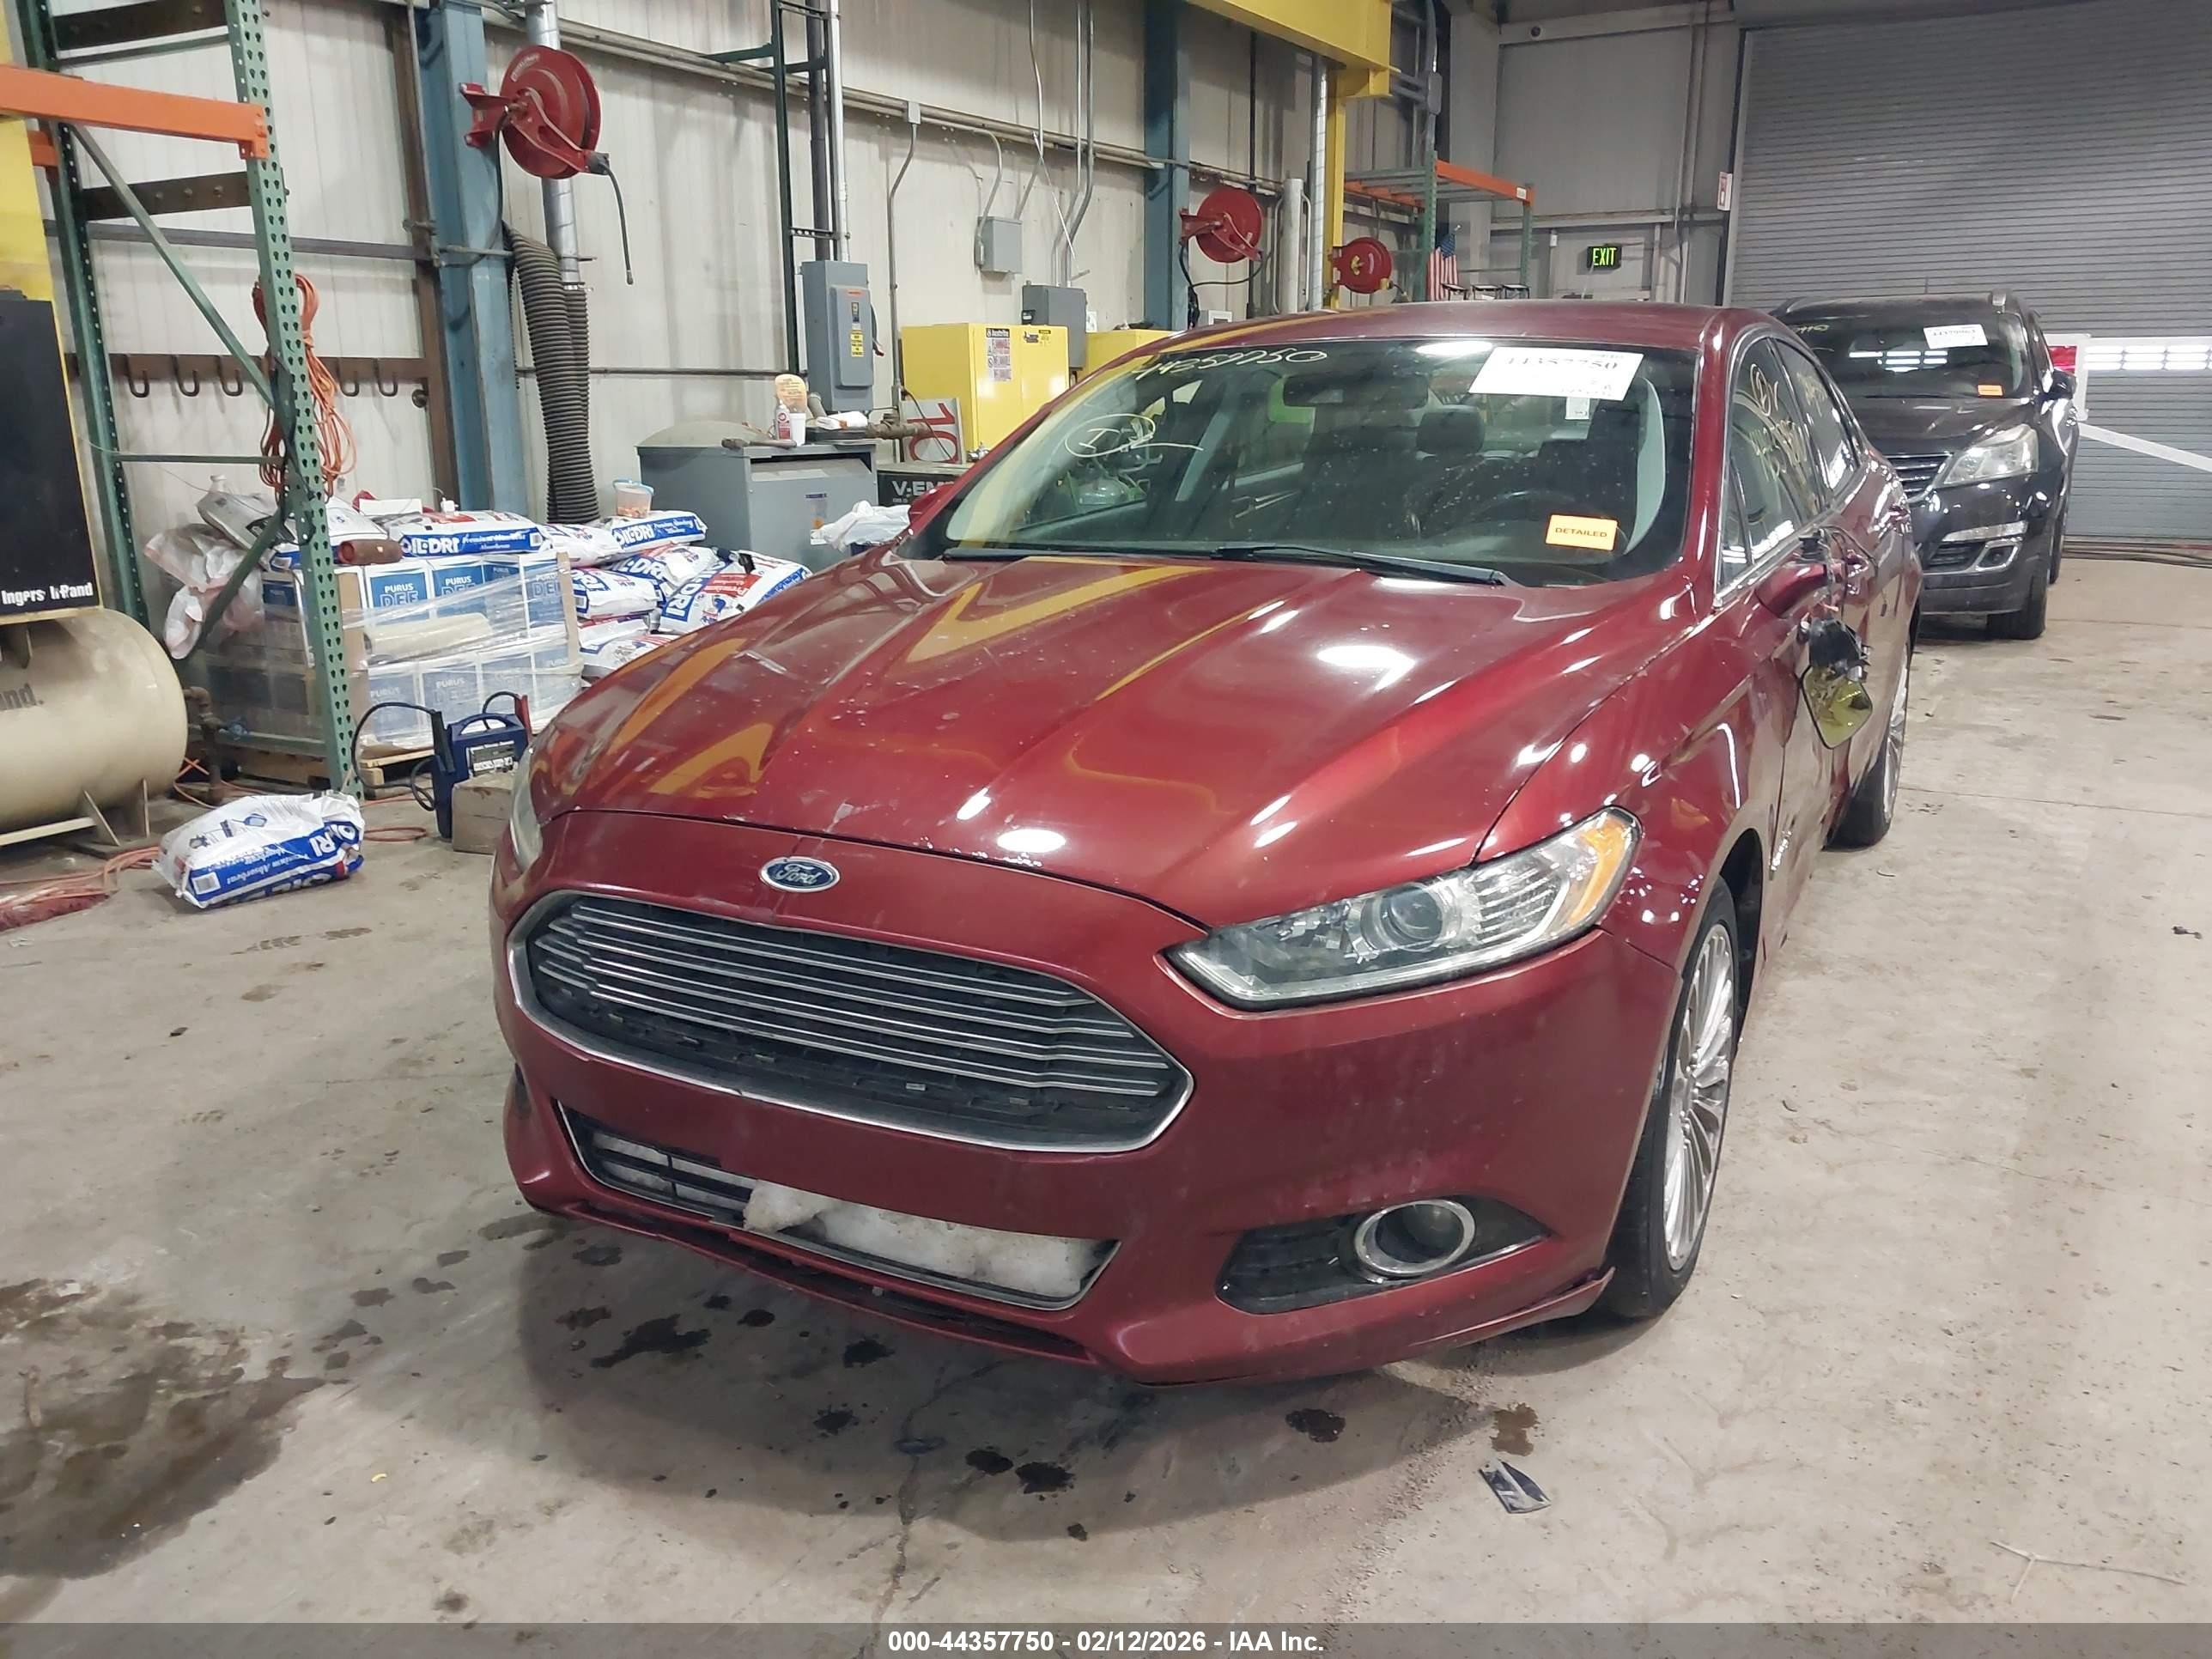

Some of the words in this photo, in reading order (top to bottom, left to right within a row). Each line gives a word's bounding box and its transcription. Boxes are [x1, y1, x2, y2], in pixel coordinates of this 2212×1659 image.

[1593, 247, 1617, 265] EXIT
[1555, 527, 1607, 538] DETAILED
[445, 575, 472, 586] PURUS
[384, 582, 414, 593] PURUS
[380, 591, 419, 607] DEF
[436, 678, 465, 689] PURUS
[226, 862, 271, 885] Absorbent
[775, 863, 823, 884] Ford
